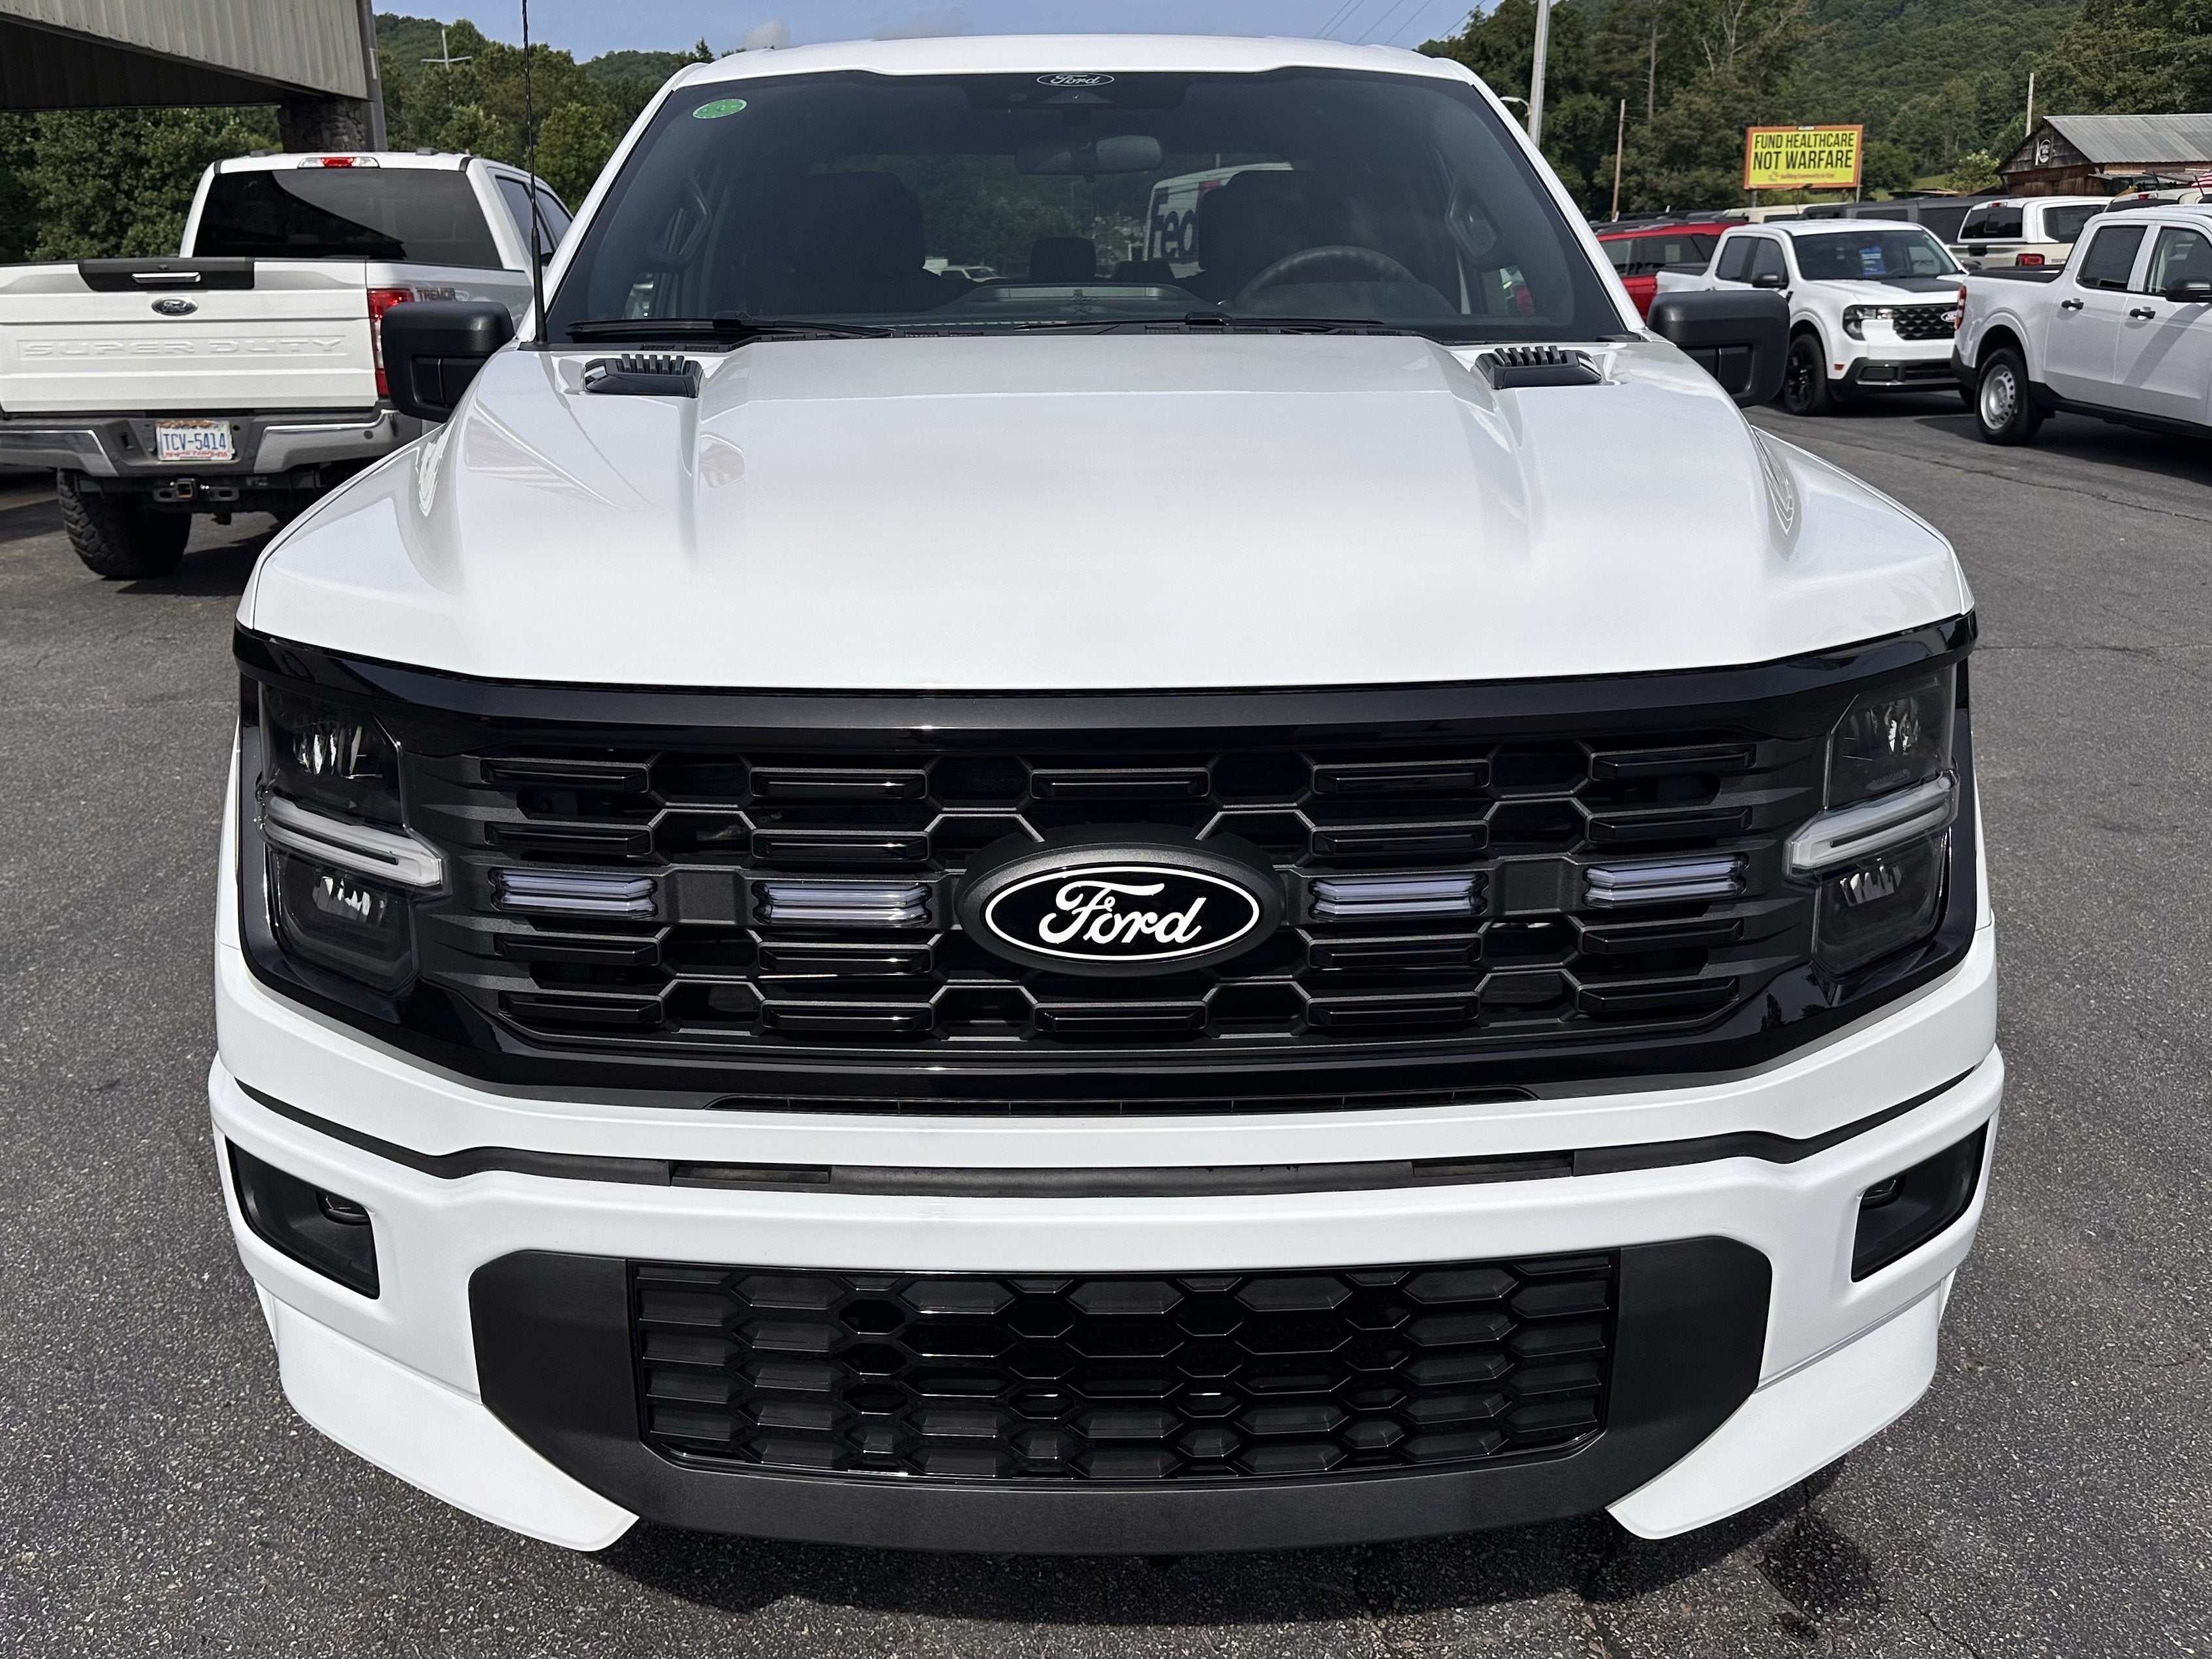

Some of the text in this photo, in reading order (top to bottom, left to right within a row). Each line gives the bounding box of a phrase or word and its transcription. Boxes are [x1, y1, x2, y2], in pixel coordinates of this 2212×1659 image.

[1050, 73, 1100, 84] Ford
[1754, 132, 1855, 149] FUND HEALTHCARE
[1752, 149, 1854, 170] NOT WARFARE
[1147, 178, 1219, 262] Fed
[24, 339, 341, 356] SUPER DUTY
[163, 433, 226, 450] TCV-5414
[1038, 880, 1207, 944] Ford
